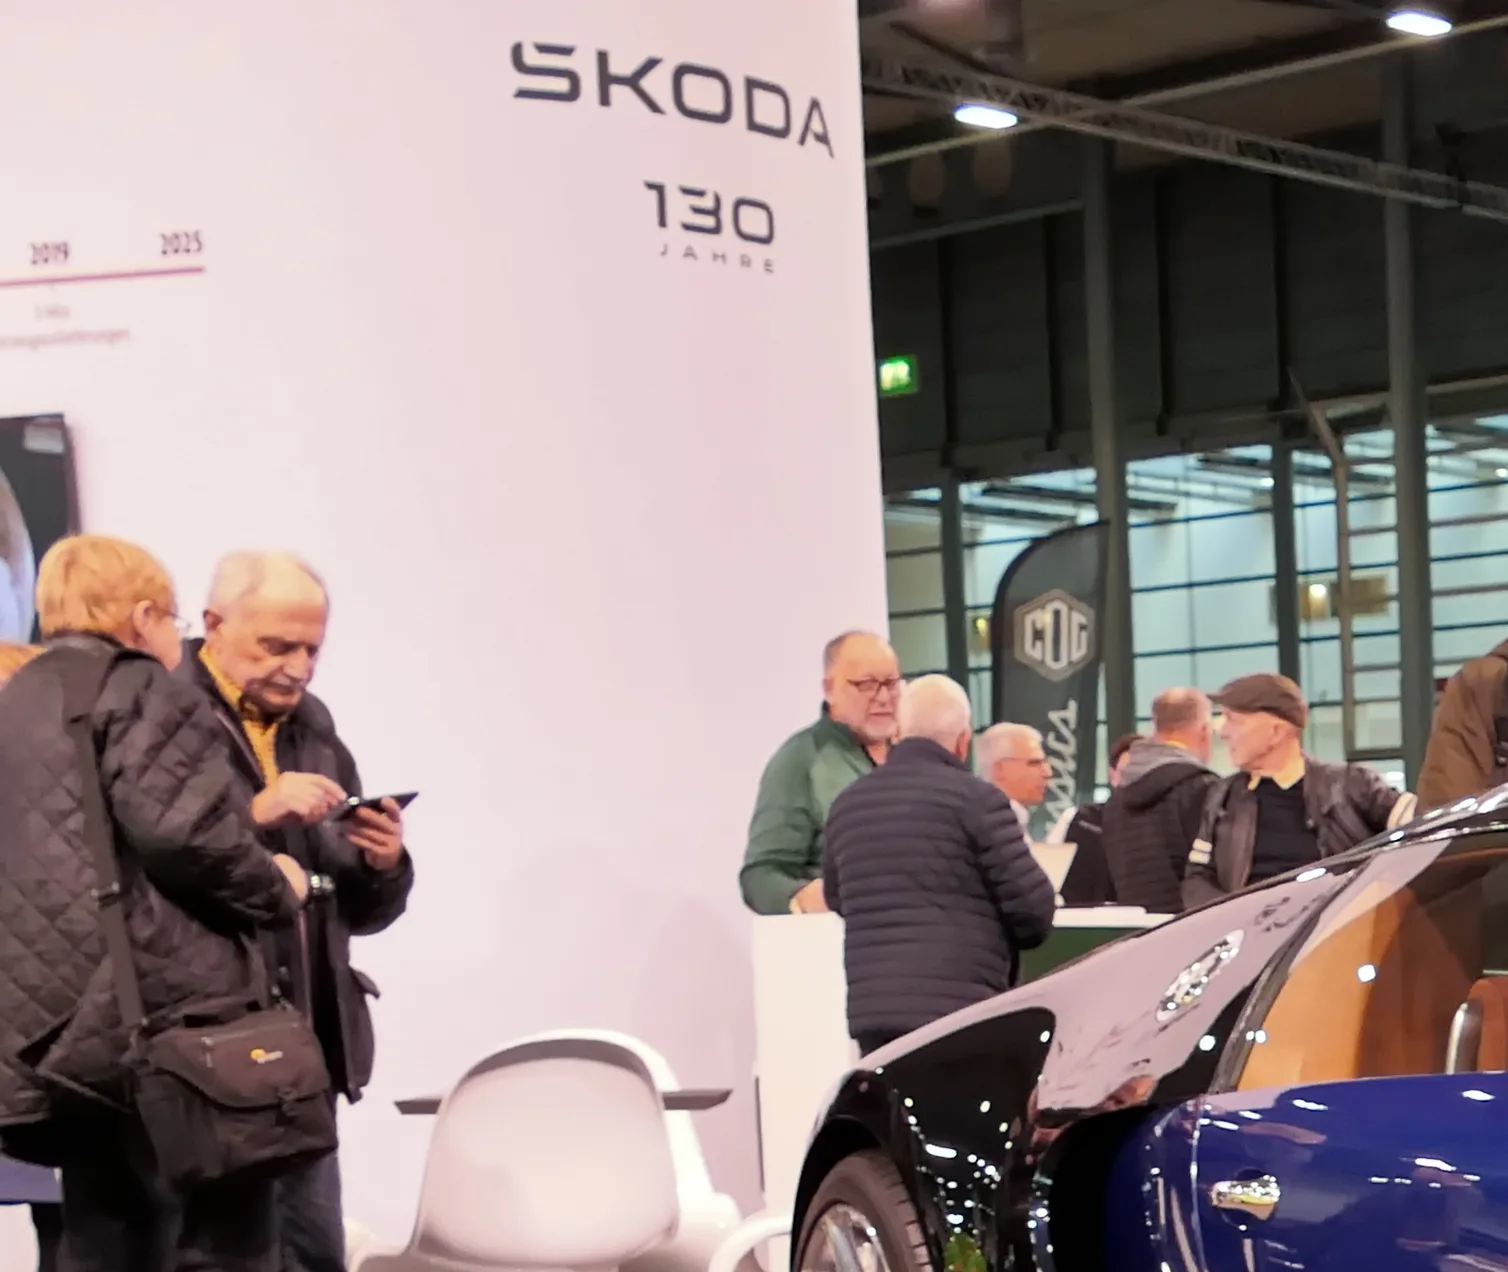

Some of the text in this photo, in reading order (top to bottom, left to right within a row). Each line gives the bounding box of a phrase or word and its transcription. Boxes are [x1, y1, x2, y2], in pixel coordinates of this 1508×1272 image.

[643, 180, 775, 245] 130
[160, 230, 203, 255] 2025
[659, 243, 775, 274] JAHRE
